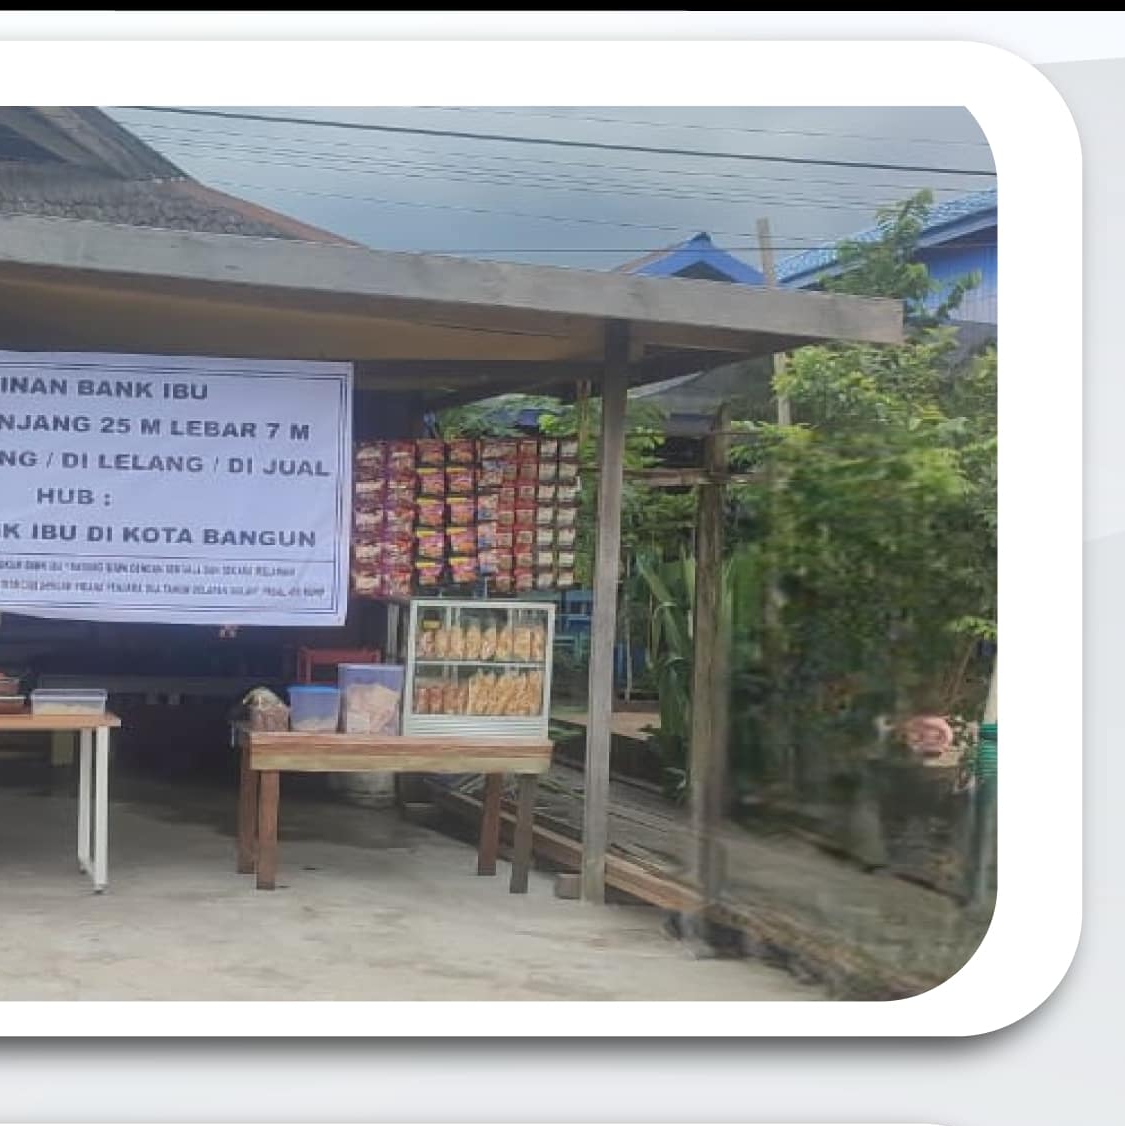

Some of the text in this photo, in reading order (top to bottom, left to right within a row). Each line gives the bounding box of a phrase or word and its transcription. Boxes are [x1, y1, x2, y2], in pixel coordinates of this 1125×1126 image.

[78, 380, 152, 398] BANK
[164, 384, 207, 399] IBU
[101, 417, 130, 433] 25
[141, 419, 160, 434] M
[171, 421, 256, 437] LEBAR
[267, 423, 280, 439] 7
[291, 425, 309, 440] M
[62, 453, 87, 468] DI
[99, 454, 203, 472] LELANG
[229, 458, 252, 474] DI
[263, 460, 330, 476] JUAL
[37, 488, 94, 504] HUB
[32, 524, 76, 541] IBU
[87, 526, 112, 542] DI
[123, 527, 193, 543] KOTA
[203, 529, 315, 547] BANGUN
